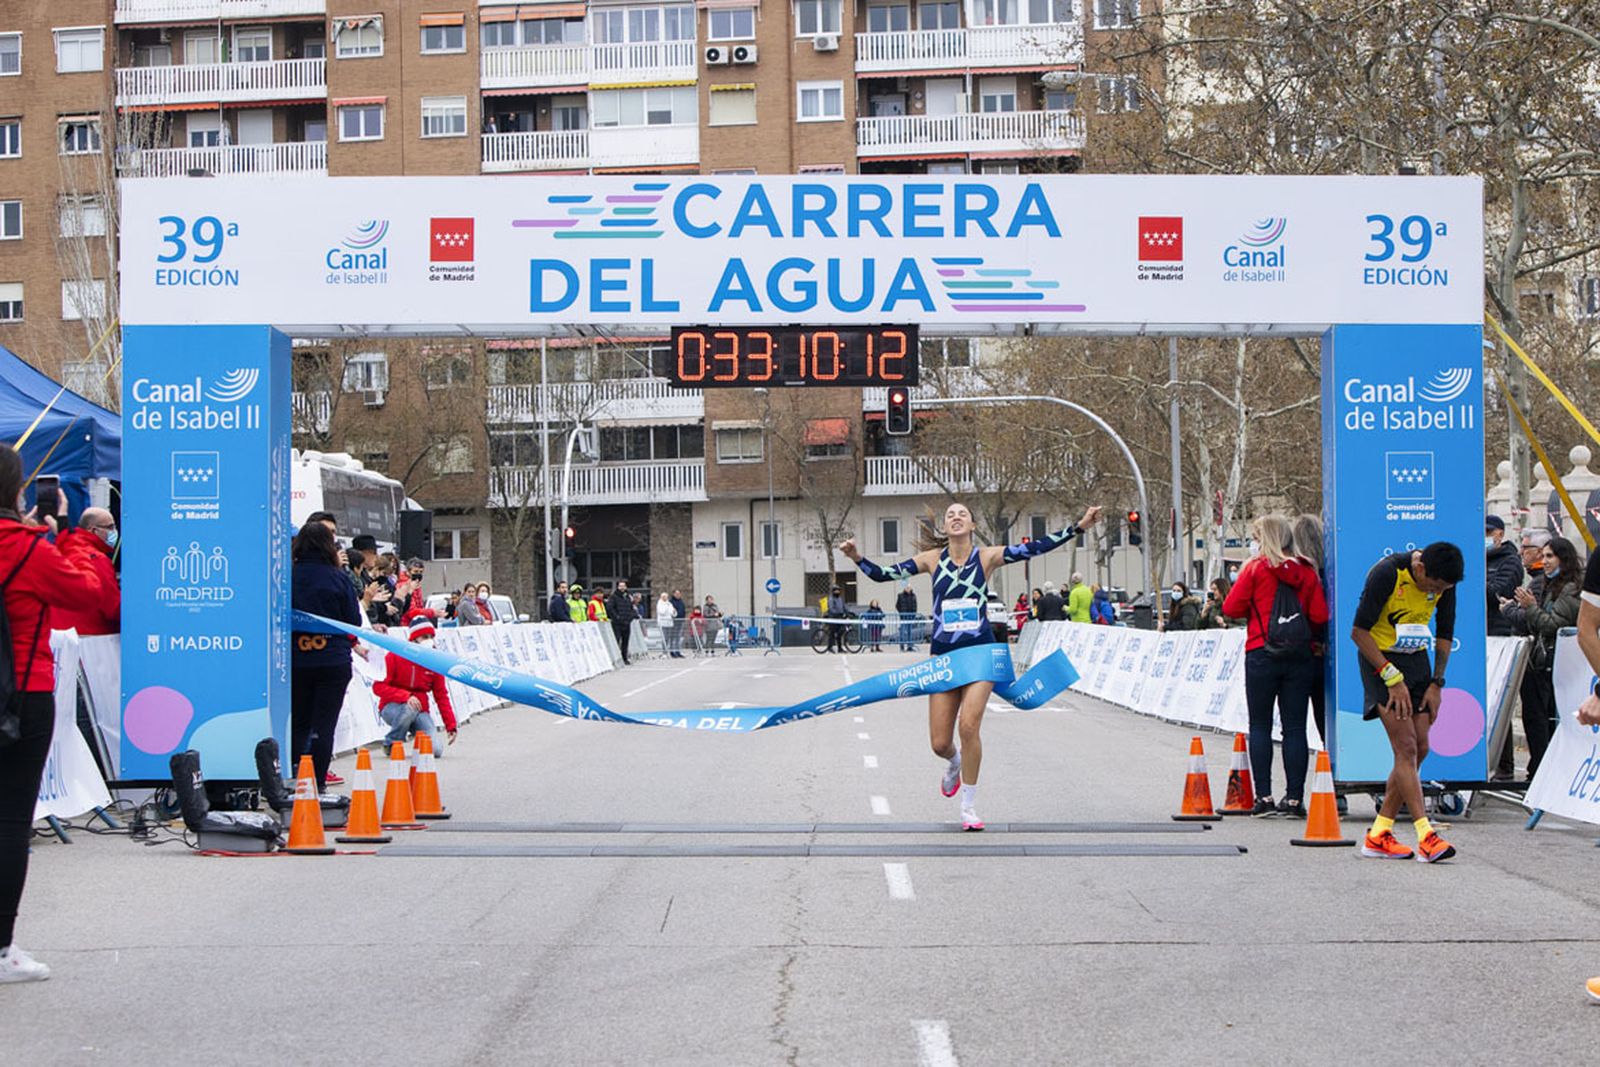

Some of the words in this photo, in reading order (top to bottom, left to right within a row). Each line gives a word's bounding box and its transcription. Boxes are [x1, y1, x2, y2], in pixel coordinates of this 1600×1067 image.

[672, 182, 1063, 240] CARRERA
[326, 248, 387, 270] Canal
[1223, 245, 1285, 268] Canal
[155, 264, 239, 287] EDICIÓN
[428, 265, 475, 273] Comunidad
[1137, 264, 1184, 272] Comunidad
[1363, 264, 1449, 287] EDICIÓN
[326, 272, 341, 284] de
[344, 272, 377, 284] Isabel
[428, 273, 441, 282] de
[443, 273, 475, 282] Madrid
[1137, 272, 1150, 281] de
[1152, 272, 1184, 281] Madrid
[1223, 270, 1238, 282] de
[1241, 270, 1276, 282] Isabel
[529, 257, 681, 314] DEL
[706, 257, 938, 314] AGUA
[131, 377, 202, 403] Canal
[1344, 377, 1415, 403] Canal
[131, 405, 163, 430] de
[169, 405, 241, 430] Isabel
[1344, 405, 1376, 431] de
[1383, 405, 1454, 431] Isabel
[171, 502, 220, 511] Comunidad
[1386, 502, 1436, 511] Comunidad
[171, 511, 184, 520] de
[186, 511, 220, 520] Madrid
[1386, 511, 1400, 521] de
[1402, 511, 1436, 521] Madrid
[155, 586, 234, 601] MADRID
[957, 611, 965, 621] 1
[170, 635, 243, 651] MADRID
[918, 668, 953, 690] Canal
[696, 717, 744, 730] DEL
